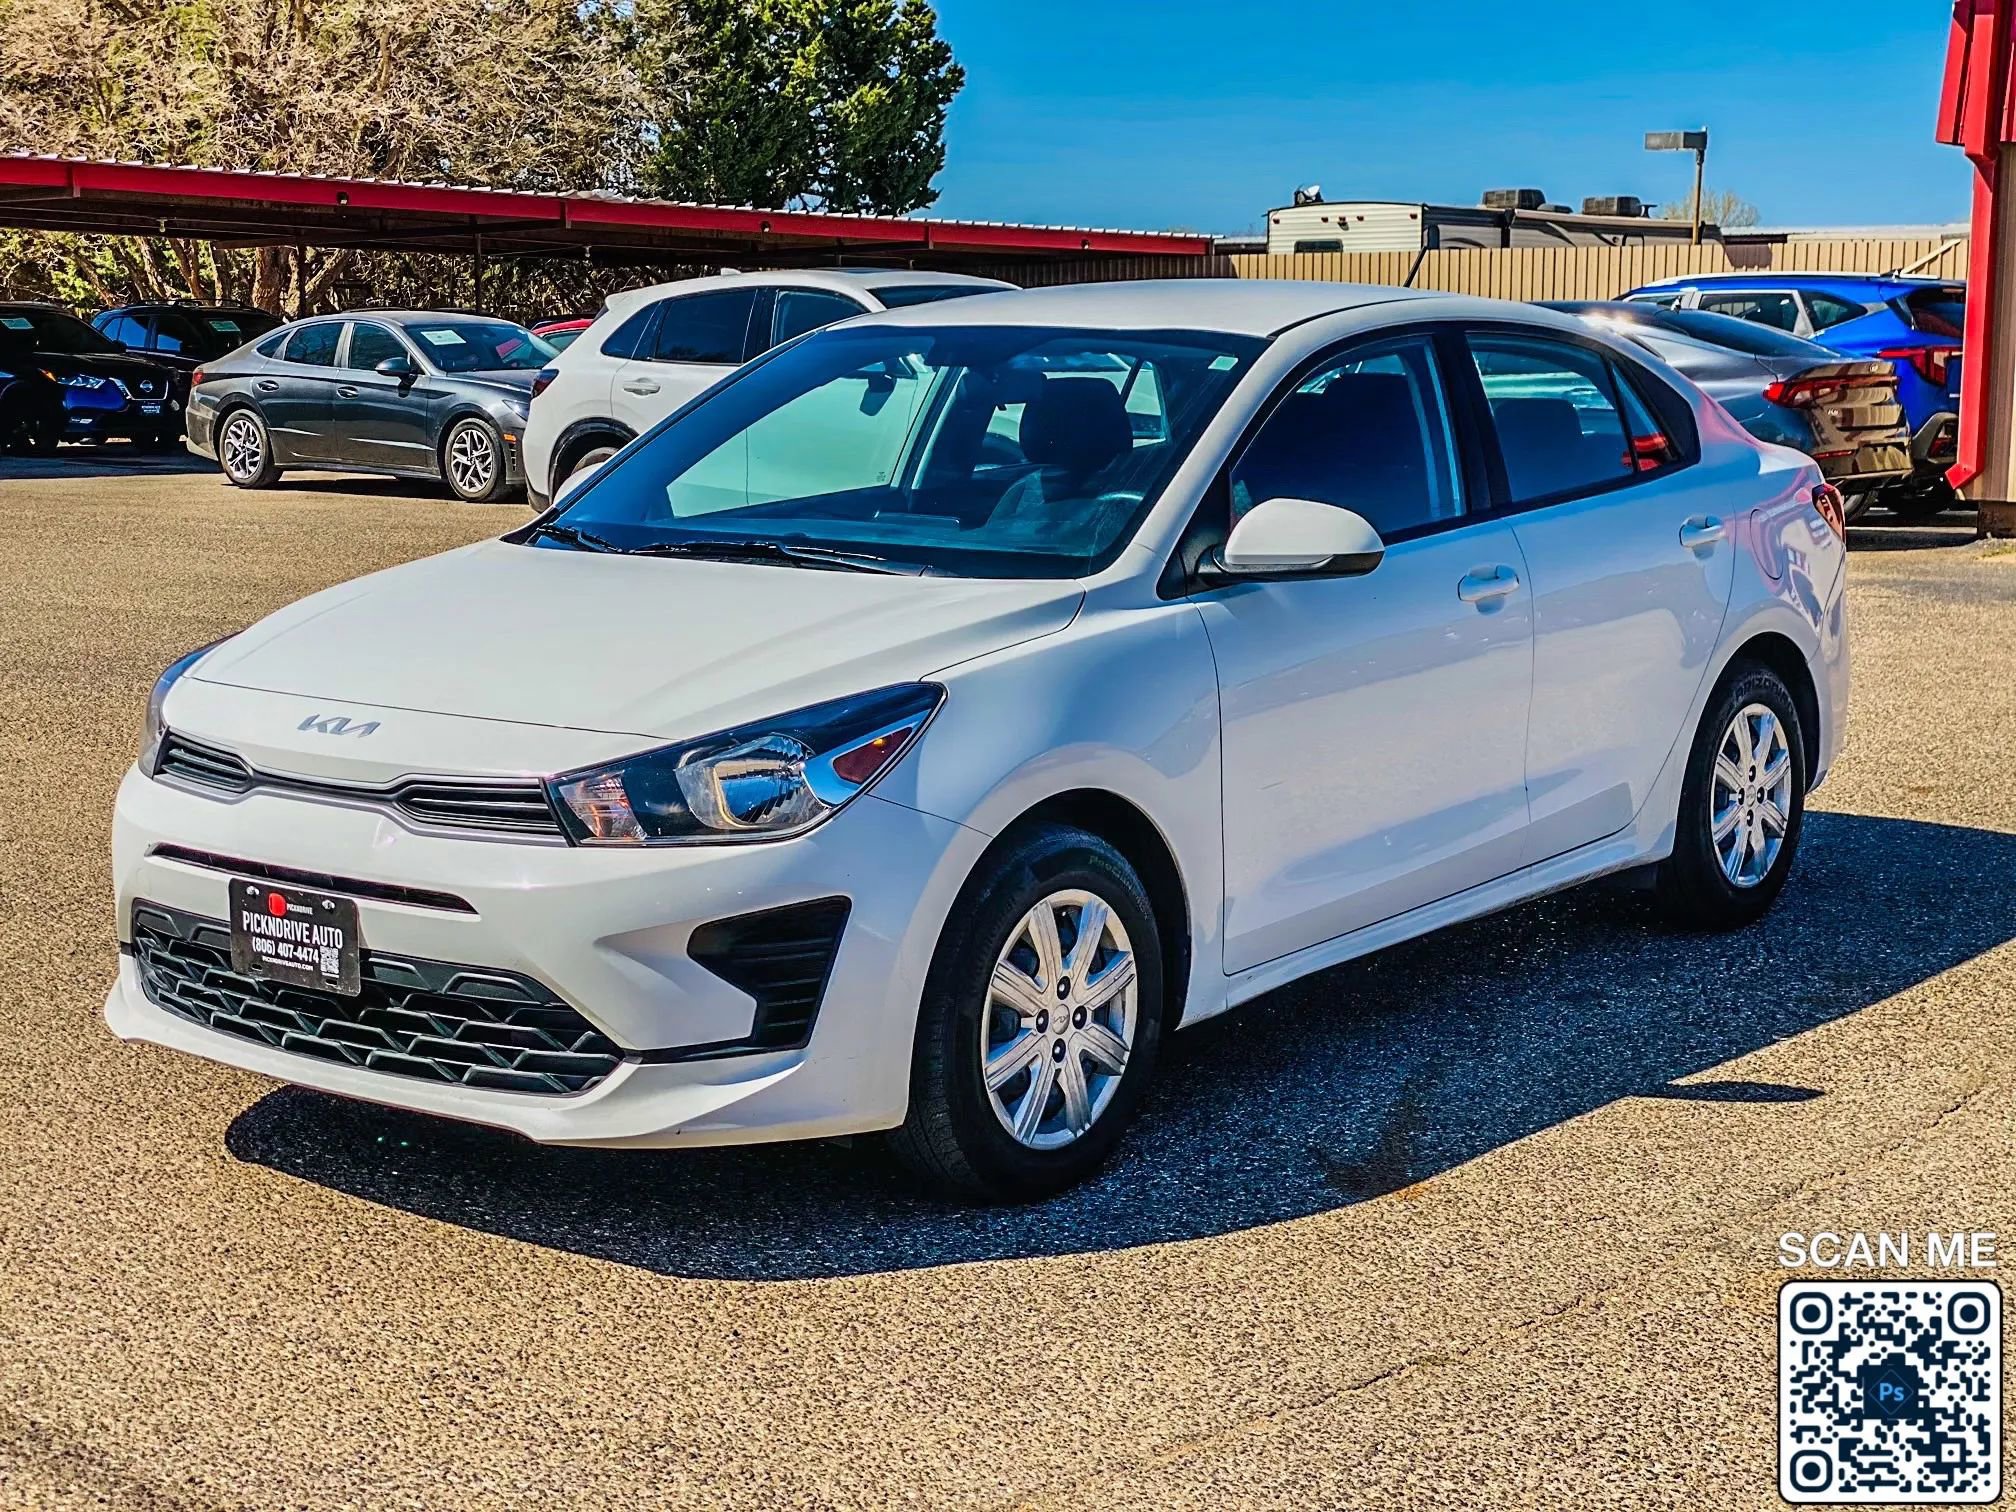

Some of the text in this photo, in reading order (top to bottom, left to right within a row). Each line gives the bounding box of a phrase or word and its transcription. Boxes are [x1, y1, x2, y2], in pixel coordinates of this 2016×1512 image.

[242, 910, 344, 949] PICKNDRIVE AUTO
[252, 936, 320, 964] (806) 407-4474
